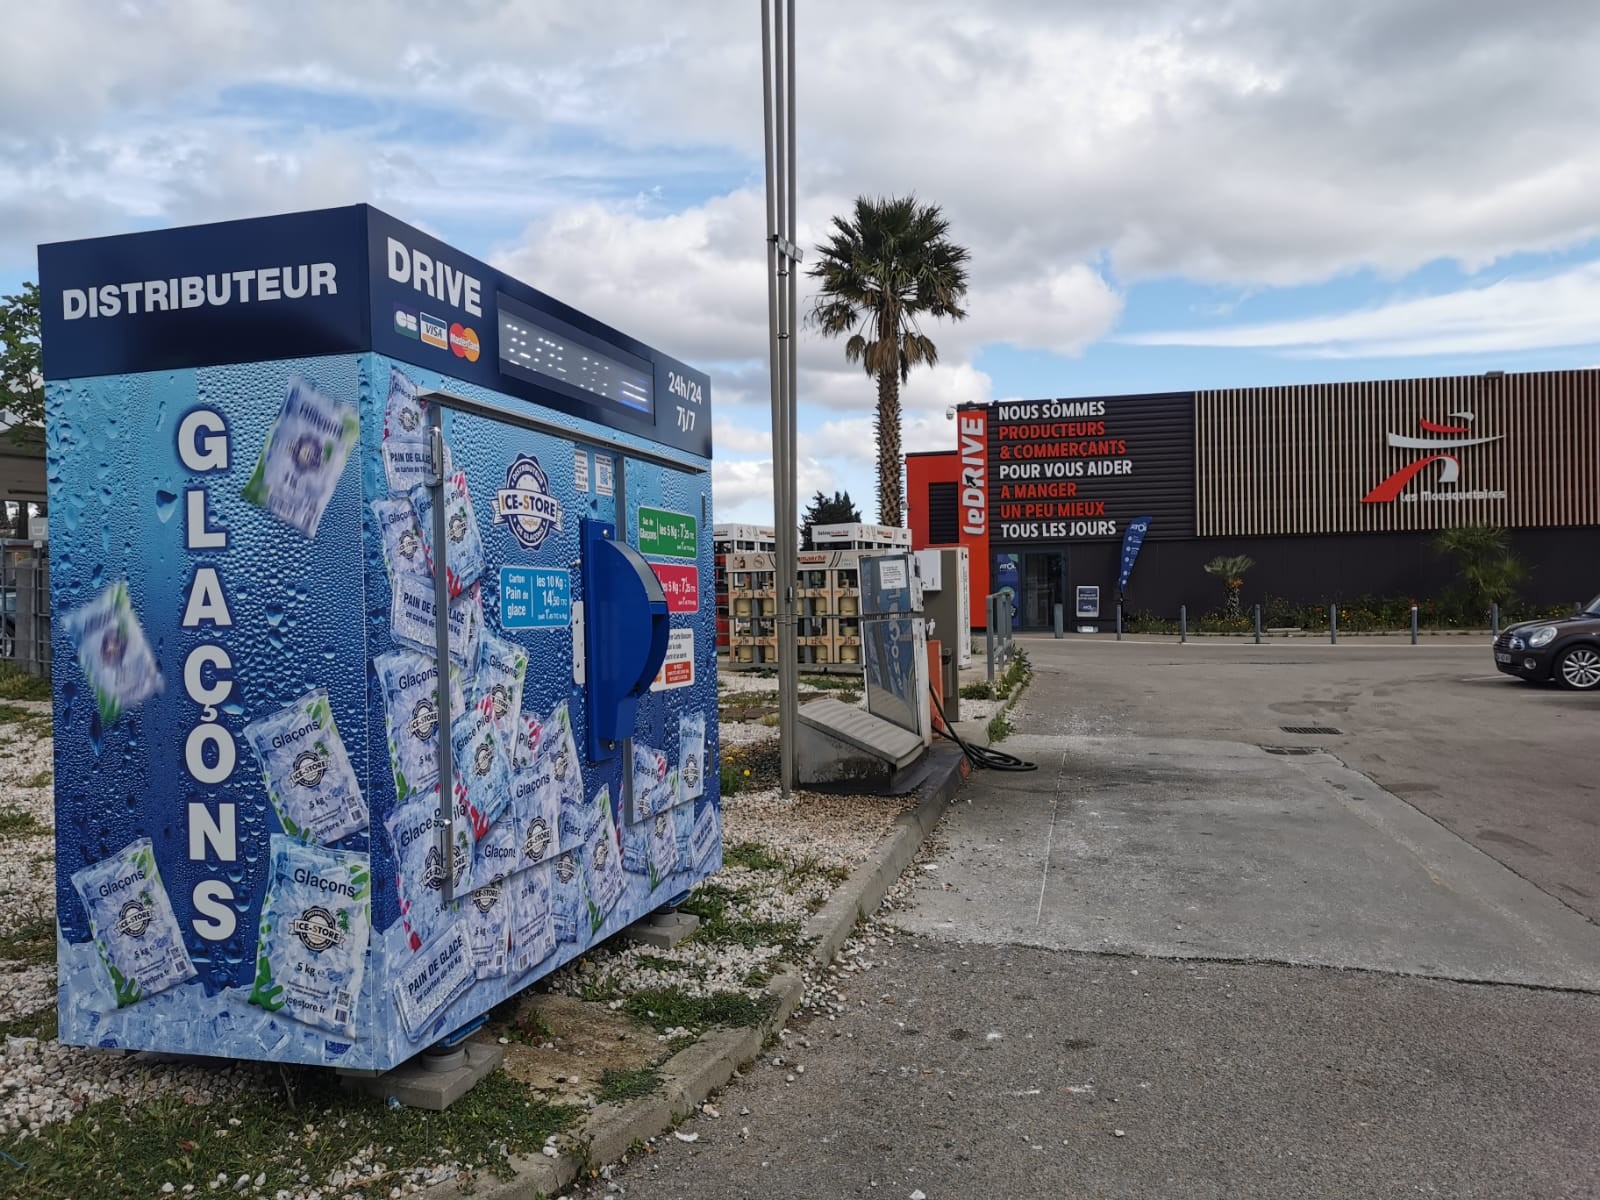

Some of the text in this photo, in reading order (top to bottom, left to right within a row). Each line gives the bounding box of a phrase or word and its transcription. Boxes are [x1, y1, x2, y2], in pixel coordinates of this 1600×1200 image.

[387, 236, 482, 318] DRIVE
[62, 262, 338, 320] DISTRIBUTEUR
[425, 324, 443, 338] VISA
[668, 371, 702, 405] 24h/24
[998, 404, 1039, 421] NOUS
[999, 421, 1105, 440] PRODUCTEURS
[999, 440, 1127, 460] & COMMERÇANTS
[999, 459, 1133, 480] POUR VOUS AIDER
[1000, 482, 1077, 499] A MANGER
[1400, 488, 1505, 502] Les Mousquetaires
[501, 494, 556, 518] ICE-STORE
[1000, 501, 1105, 519] UN PEU MIEUX
[1000, 520, 1117, 539] TOUS LES JOURS
[536, 575, 546, 588] les
[546, 575, 555, 588] 10
[403, 592, 420, 611] PAIN
[421, 600, 430, 614] DE
[506, 586, 521, 600] Pain
[507, 603, 526, 619] glace
[178, 410, 237, 941] GLAÇONS
[398, 667, 439, 690] Glaçons
[271, 720, 321, 749] Glaçons
[400, 818, 432, 848] Glace
[98, 870, 145, 897] Glaçons
[294, 868, 356, 898] Glaçons
[295, 921, 340, 941] ICE-STORE
[297, 962, 316, 979] 5 kg
[408, 935, 463, 996] PAIN DE GLACE
